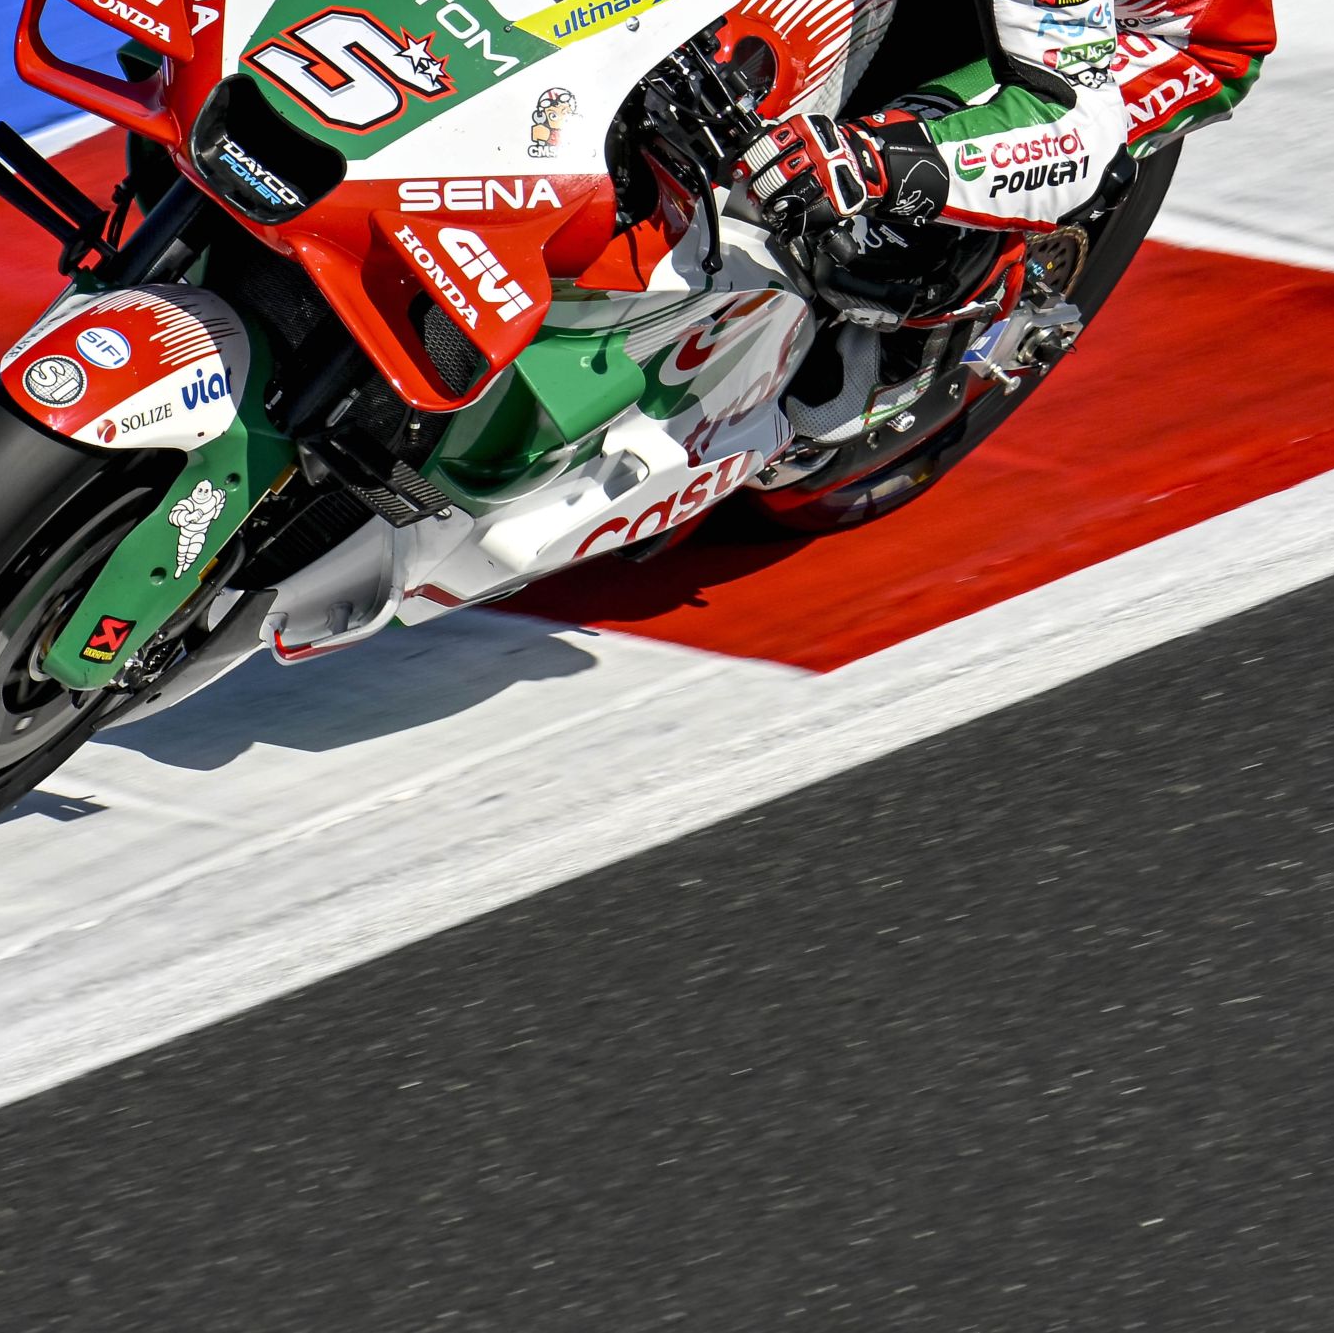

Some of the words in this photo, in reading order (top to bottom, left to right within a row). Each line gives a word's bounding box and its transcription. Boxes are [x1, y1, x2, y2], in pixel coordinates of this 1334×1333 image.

[239, 5, 458, 132] 5
[990, 128, 1085, 169] Castrol
[219, 153, 282, 205] POWER
[223, 140, 299, 205] DAYCO
[397, 180, 562, 212] SENA
[989, 156, 1090, 198] POWER1
[394, 224, 479, 331] HONDA
[437, 227, 535, 323] GIVI
[81, 330, 126, 366] SIFI
[121, 403, 173, 434] SOLIZE
